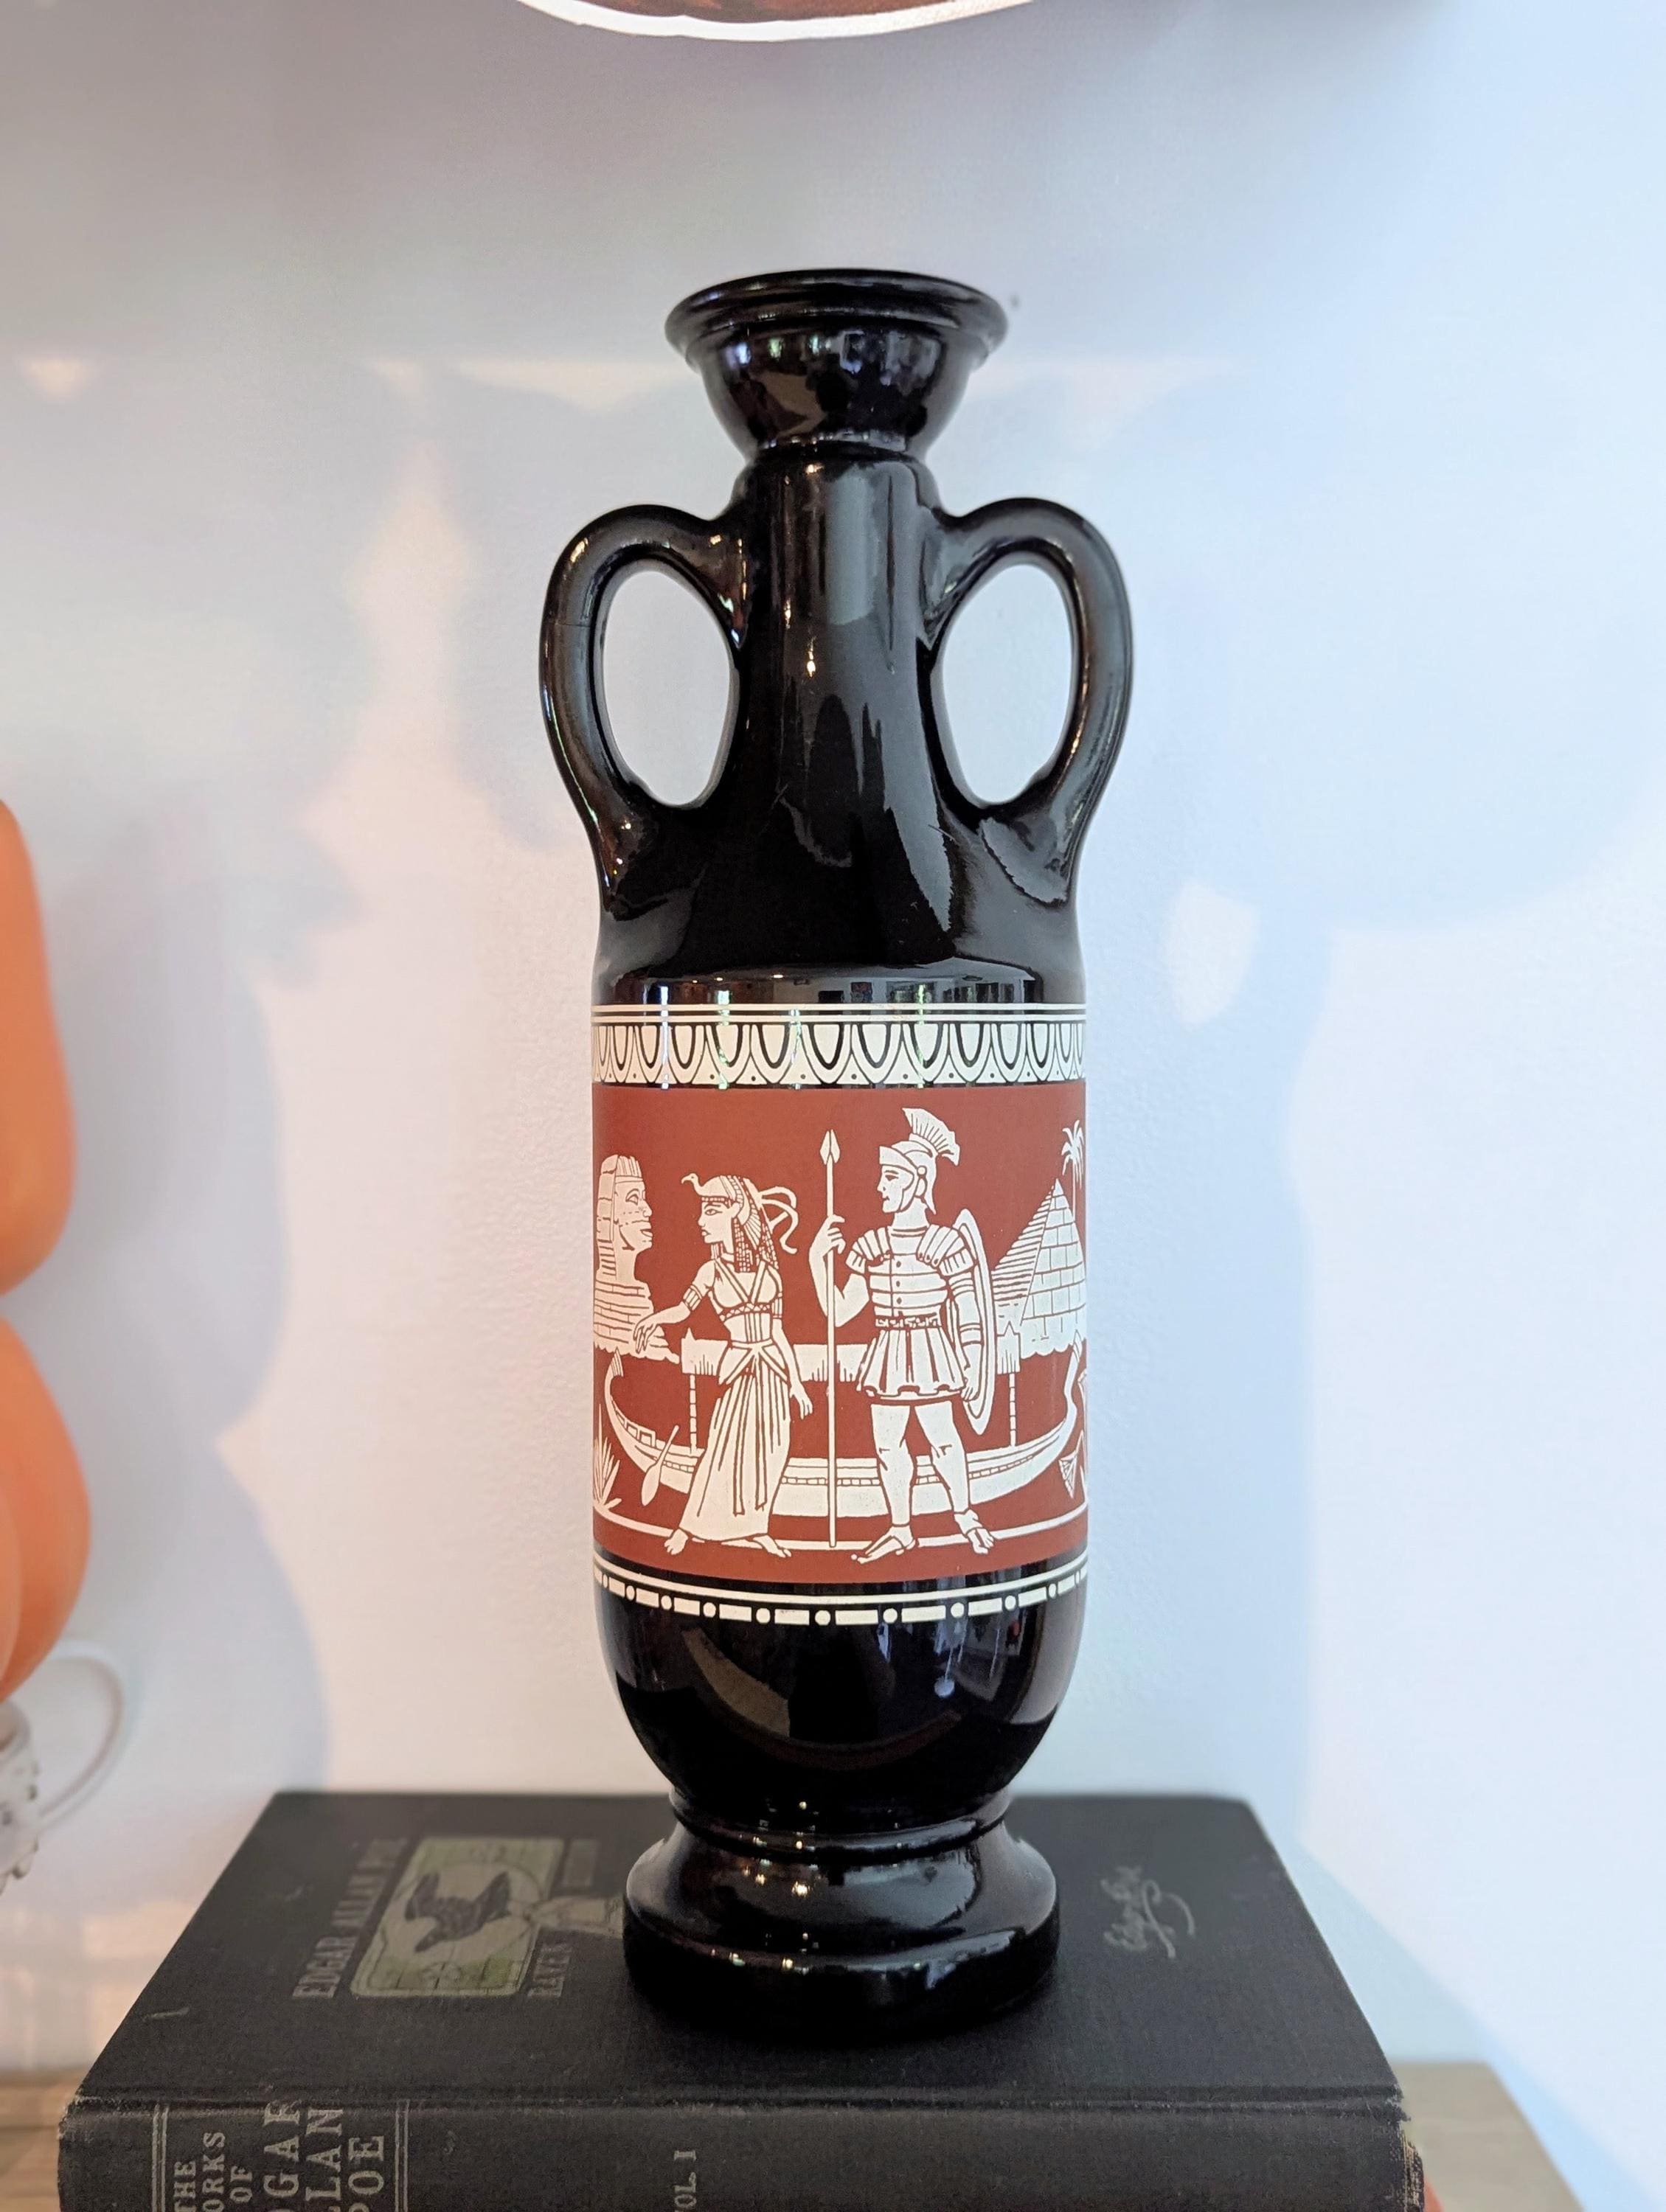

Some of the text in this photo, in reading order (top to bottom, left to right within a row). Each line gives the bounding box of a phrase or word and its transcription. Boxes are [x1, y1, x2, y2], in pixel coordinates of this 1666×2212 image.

[202, 2132, 226, 2212] ORKS
[229, 2165, 253, 2203] OF
[263, 2100, 302, 2212] GAR
[305, 2109, 344, 2212] LAN
[347, 2135, 384, 2212] OE
